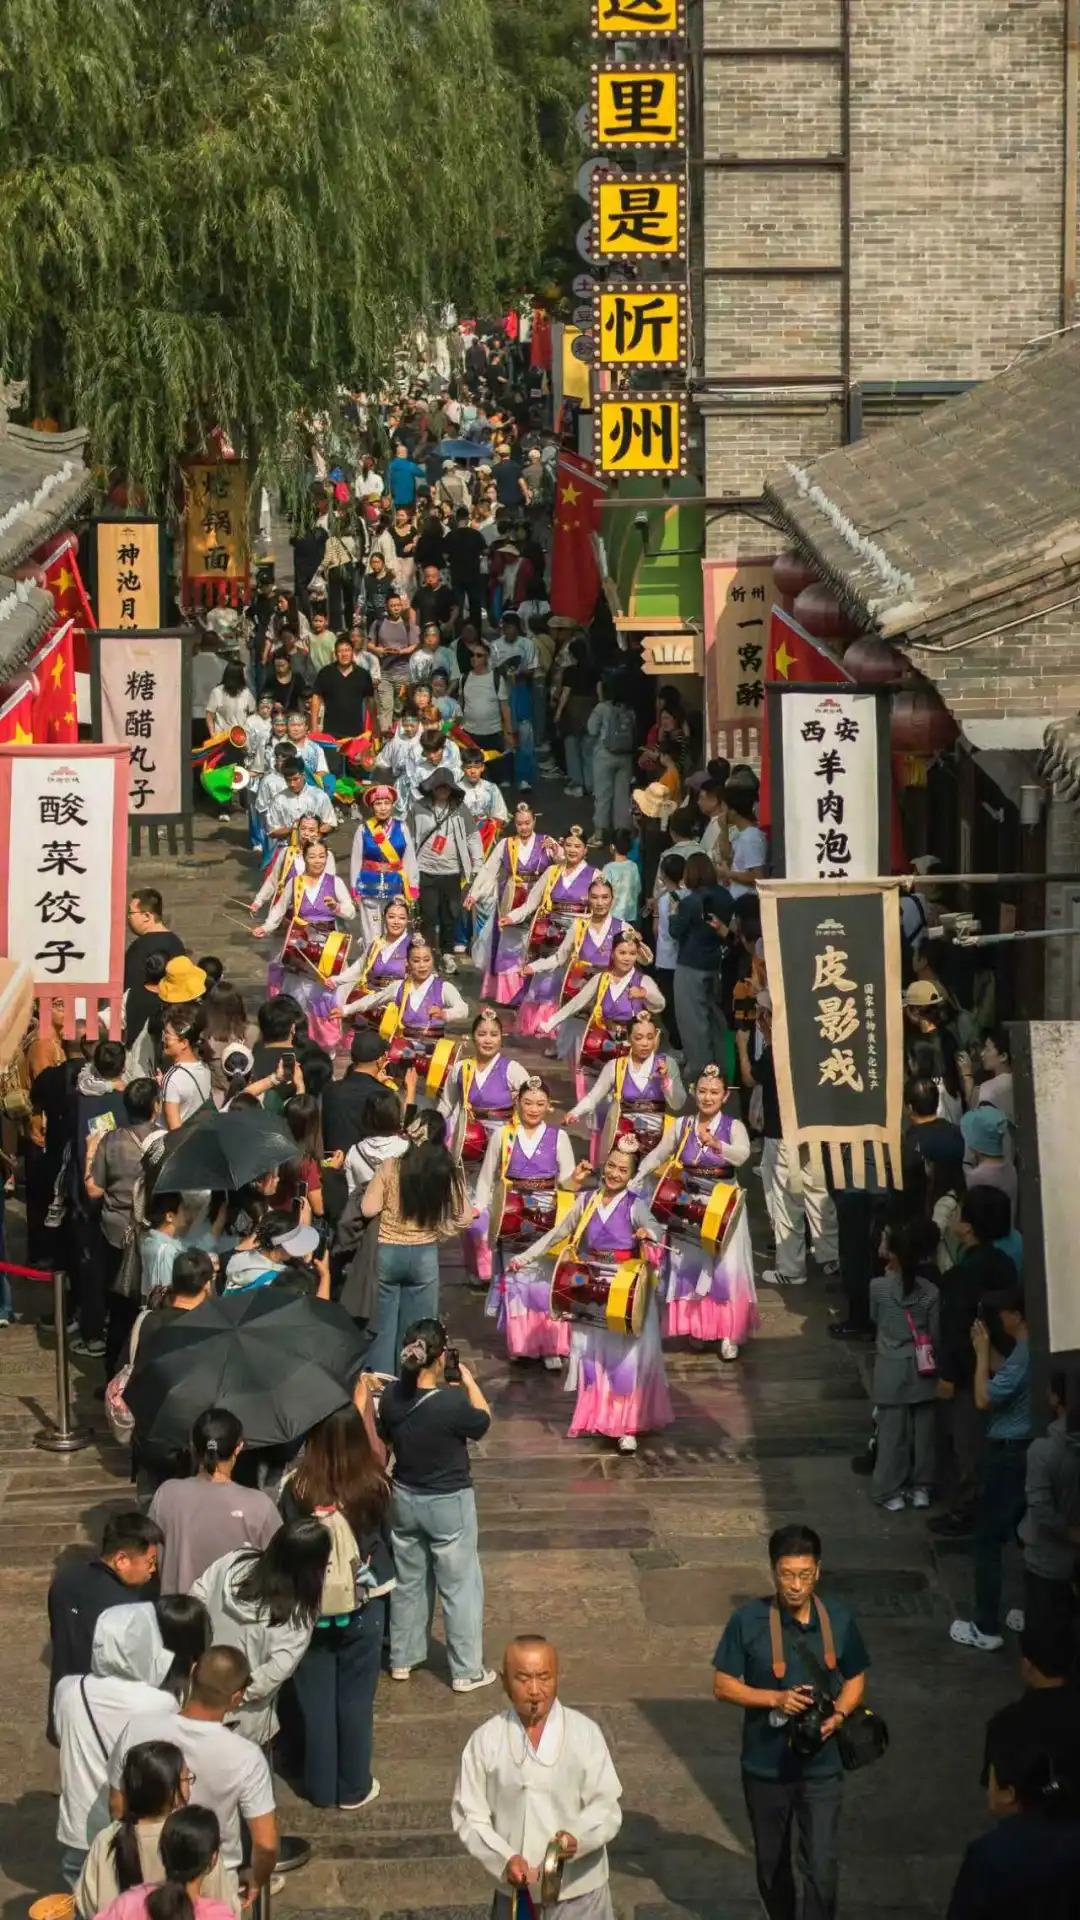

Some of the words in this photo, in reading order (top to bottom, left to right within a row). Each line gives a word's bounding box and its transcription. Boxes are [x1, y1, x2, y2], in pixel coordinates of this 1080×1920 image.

[117, 543, 141, 629] 神池月
[731, 585, 766, 603] 忻州
[736, 618, 765, 708] 一窝酥
[125, 670, 156, 809] 糖醋丸子
[801, 717, 860, 743] 西安
[814, 749, 851, 878] 羊肉泡
[34, 792, 88, 974] 酸菜饺子
[812, 945, 864, 1093] 皮影戏
